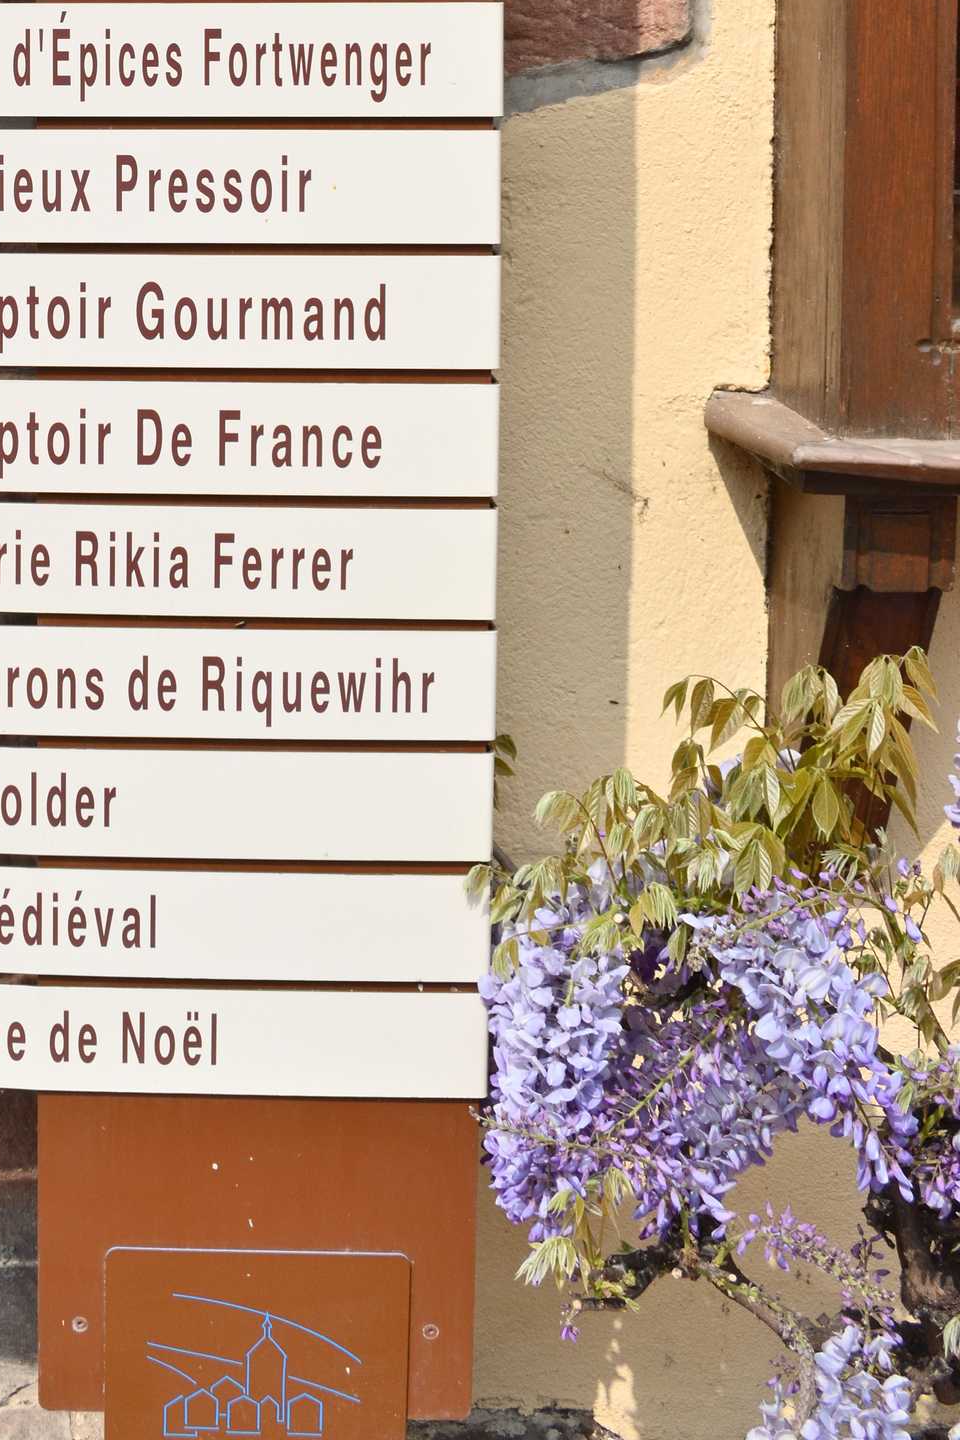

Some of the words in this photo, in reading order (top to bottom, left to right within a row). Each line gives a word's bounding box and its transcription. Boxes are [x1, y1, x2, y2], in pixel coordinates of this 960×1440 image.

[12, 10, 183, 102] d'Épices
[204, 28, 432, 103] Fortwenger
[116, 154, 312, 214] Pressoir
[136, 281, 386, 342] Gourmand
[136, 408, 193, 467] De
[218, 409, 382, 469] France
[75, 530, 189, 589] Rikia
[214, 532, 354, 591] Ferrer
[128, 655, 177, 712] de
[202, 655, 435, 728] Riquewihr
[49, 1010, 98, 1064] de
[122, 1011, 217, 1066] Noël
